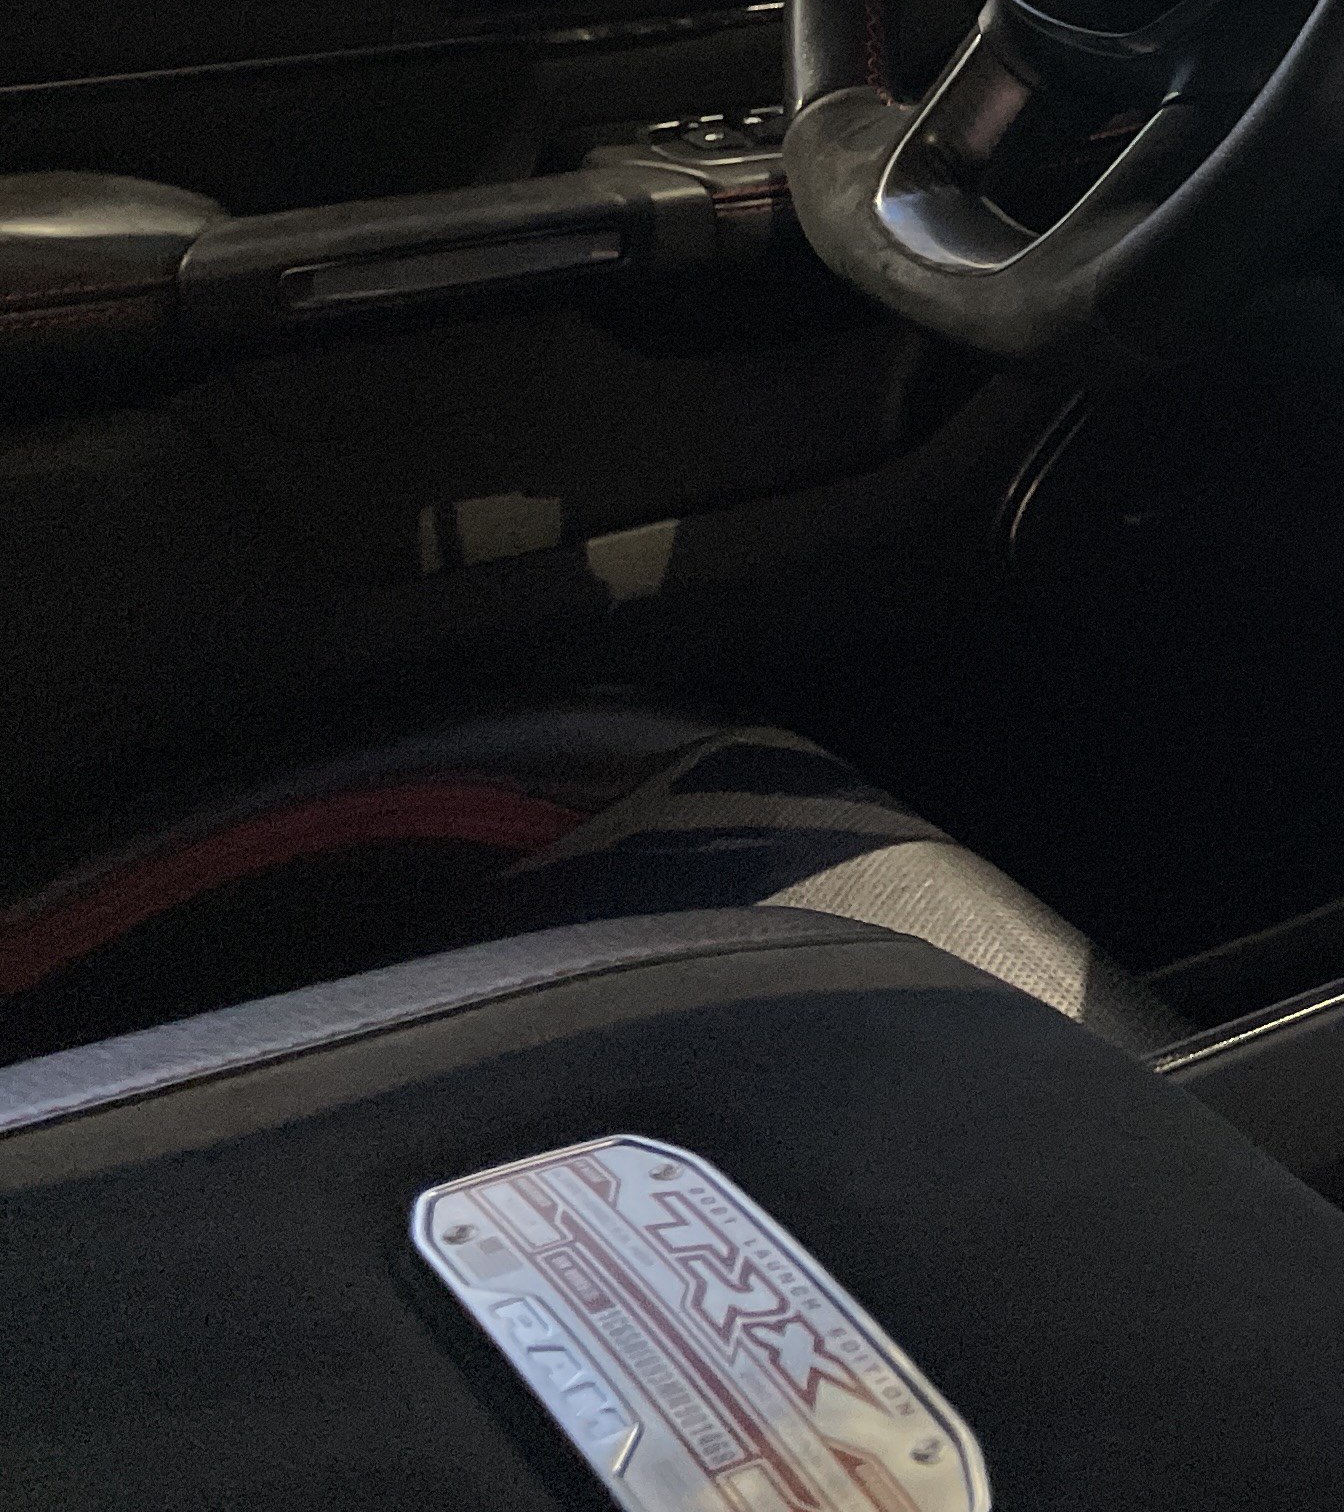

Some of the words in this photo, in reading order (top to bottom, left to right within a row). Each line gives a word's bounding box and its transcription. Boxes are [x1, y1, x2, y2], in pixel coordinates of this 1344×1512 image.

[644, 1188, 895, 1419] TRX
[743, 1238, 823, 1311] LAUNCH
[826, 1327, 916, 1417] EDITION
